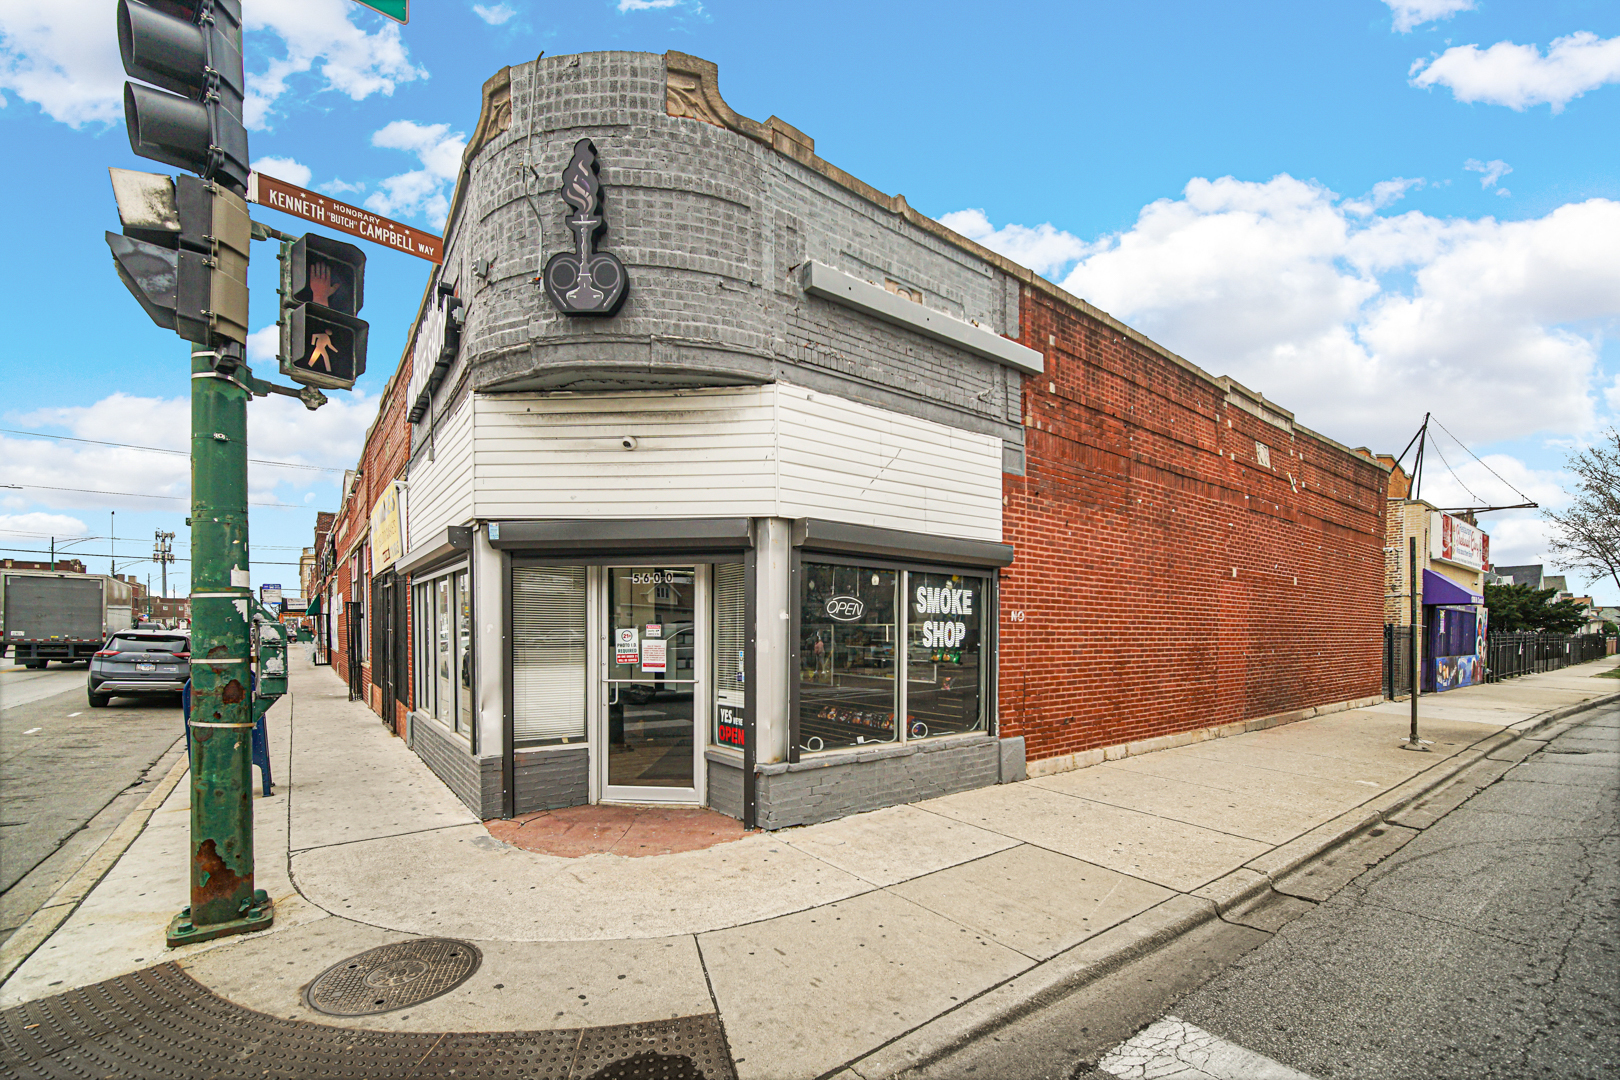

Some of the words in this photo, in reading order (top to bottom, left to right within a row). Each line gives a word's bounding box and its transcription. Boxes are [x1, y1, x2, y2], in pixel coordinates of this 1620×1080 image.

[269, 189, 325, 221] KENNETH
[326, 211, 358, 230] "BUTCH"
[359, 220, 414, 252] CAMPBELL
[418, 242, 435, 256] WAY
[333, 203, 380, 225] HONORARY
[633, 573, 673, 583] 5600
[826, 600, 864, 616] OPEN
[916, 586, 973, 615] SMOKE
[1011, 610, 1025, 622] NO
[922, 620, 966, 648] SHOP
[720, 708, 732, 724] YES
[718, 724, 745, 745] OPEN
